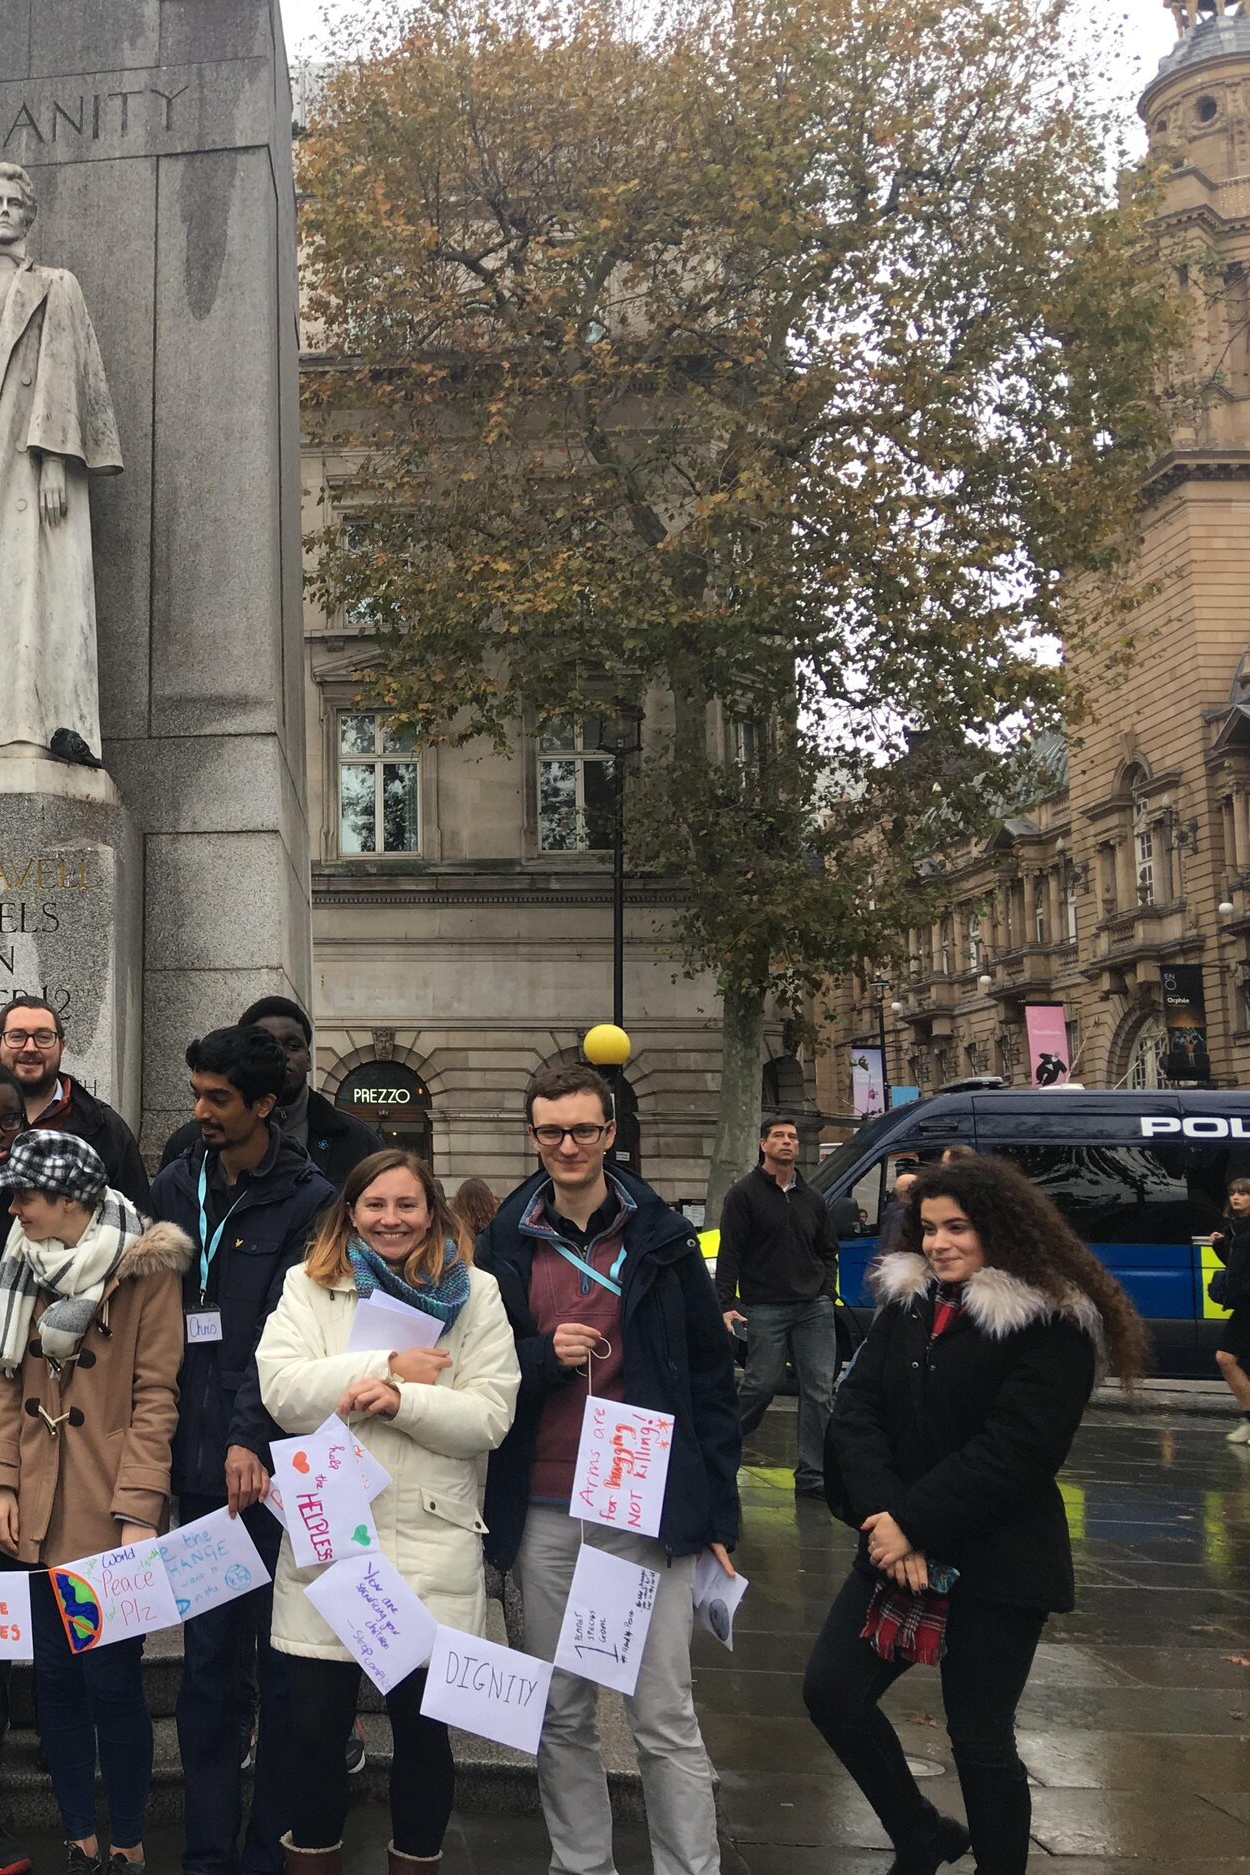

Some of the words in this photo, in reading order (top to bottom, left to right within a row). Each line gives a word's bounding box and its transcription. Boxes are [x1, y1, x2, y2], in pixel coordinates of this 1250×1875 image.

[353, 1088, 411, 1104] PREZZO
[578, 1450, 601, 1508] Arms
[593, 1407, 606, 1440] are
[314, 1473, 328, 1491] the
[627, 1489, 644, 1529] NOT
[296, 1492, 334, 1562] HELPLESS
[101, 1547, 136, 1569] World
[167, 1539, 230, 1578] HANGE
[102, 1568, 155, 1598] Peace
[120, 1598, 157, 1626] Plz
[444, 1650, 538, 1708] DIGNITY
